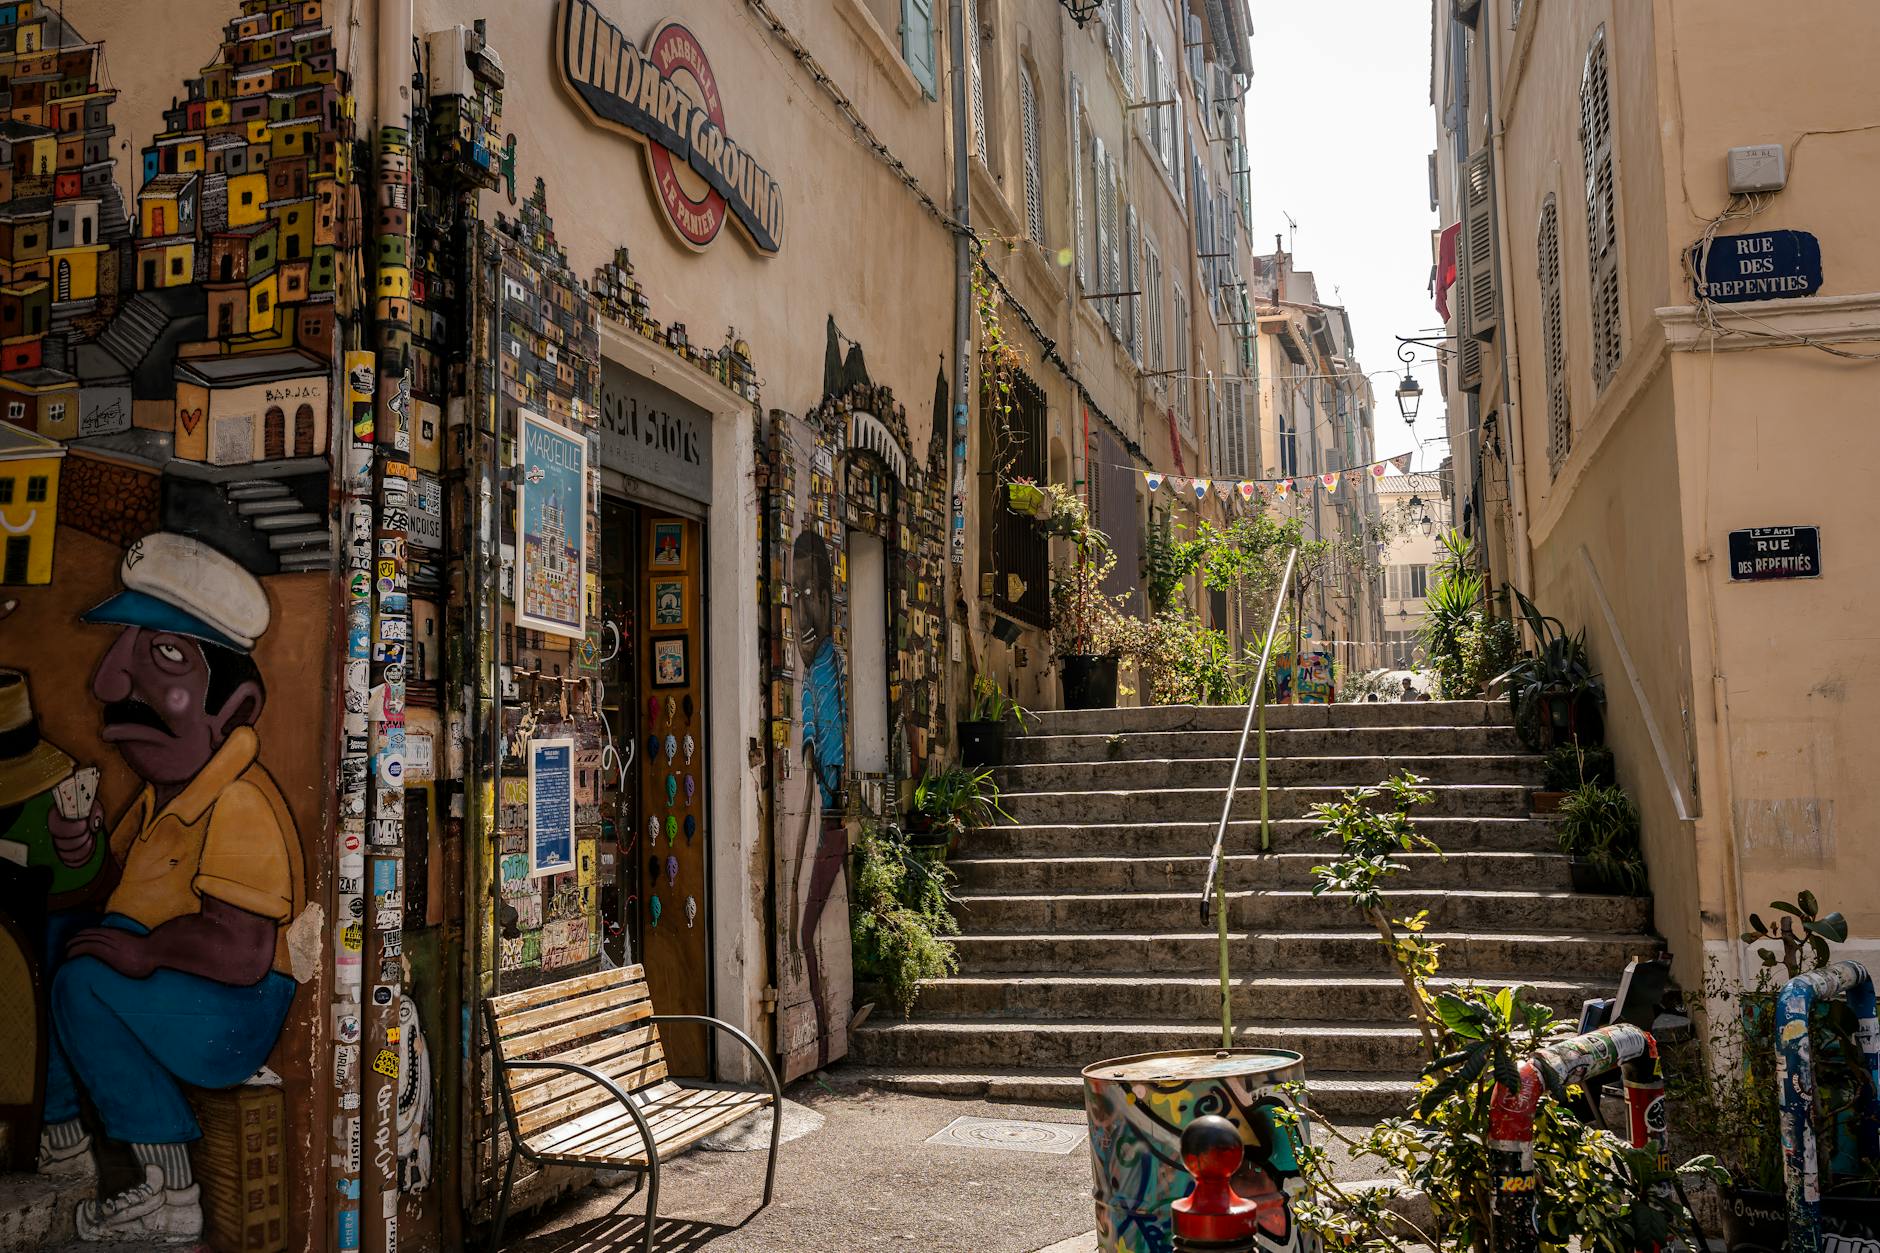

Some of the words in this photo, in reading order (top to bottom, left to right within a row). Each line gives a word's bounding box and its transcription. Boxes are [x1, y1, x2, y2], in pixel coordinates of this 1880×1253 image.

[661, 37, 717, 111] MARSEILLE
[662, 172, 677, 208] LE
[676, 203, 716, 236] PANIER
[1736, 237, 1774, 255] RUE
[1739, 257, 1774, 275] DES
[1709, 275, 1809, 297] REPENTIES
[265, 387, 321, 402] BARJAC
[526, 425, 581, 474] MARSEILLE
[1757, 539, 1790, 552] RUE
[1738, 561, 1753, 574] DES
